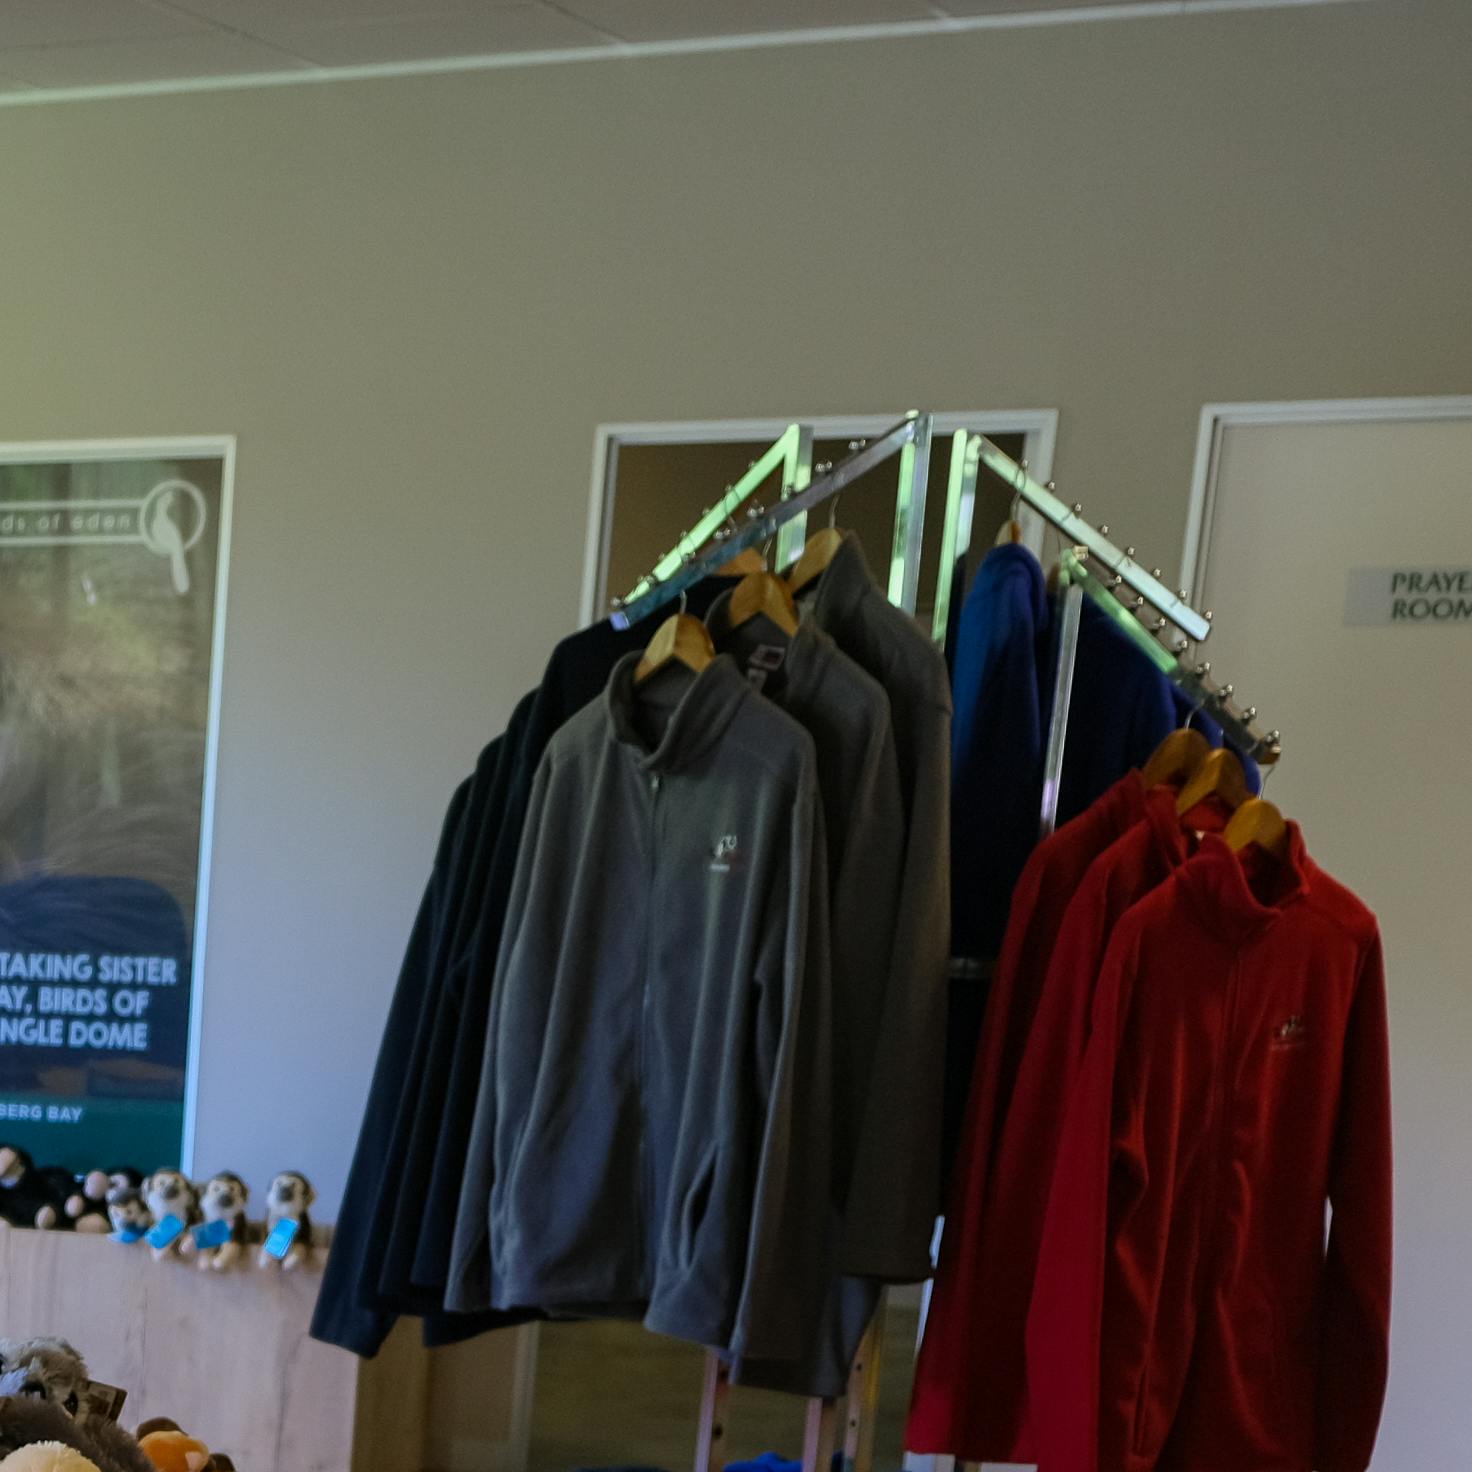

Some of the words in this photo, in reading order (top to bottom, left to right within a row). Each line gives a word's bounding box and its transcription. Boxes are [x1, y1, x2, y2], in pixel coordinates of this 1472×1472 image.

[38, 514, 60, 530] of
[70, 513, 131, 530] eden
[98, 955, 177, 984] SISTER
[37, 986, 108, 1014] BIRDS
[112, 989, 150, 1017] OF
[68, 1021, 147, 1050] DOME
[46, 1105, 83, 1123] BAY
